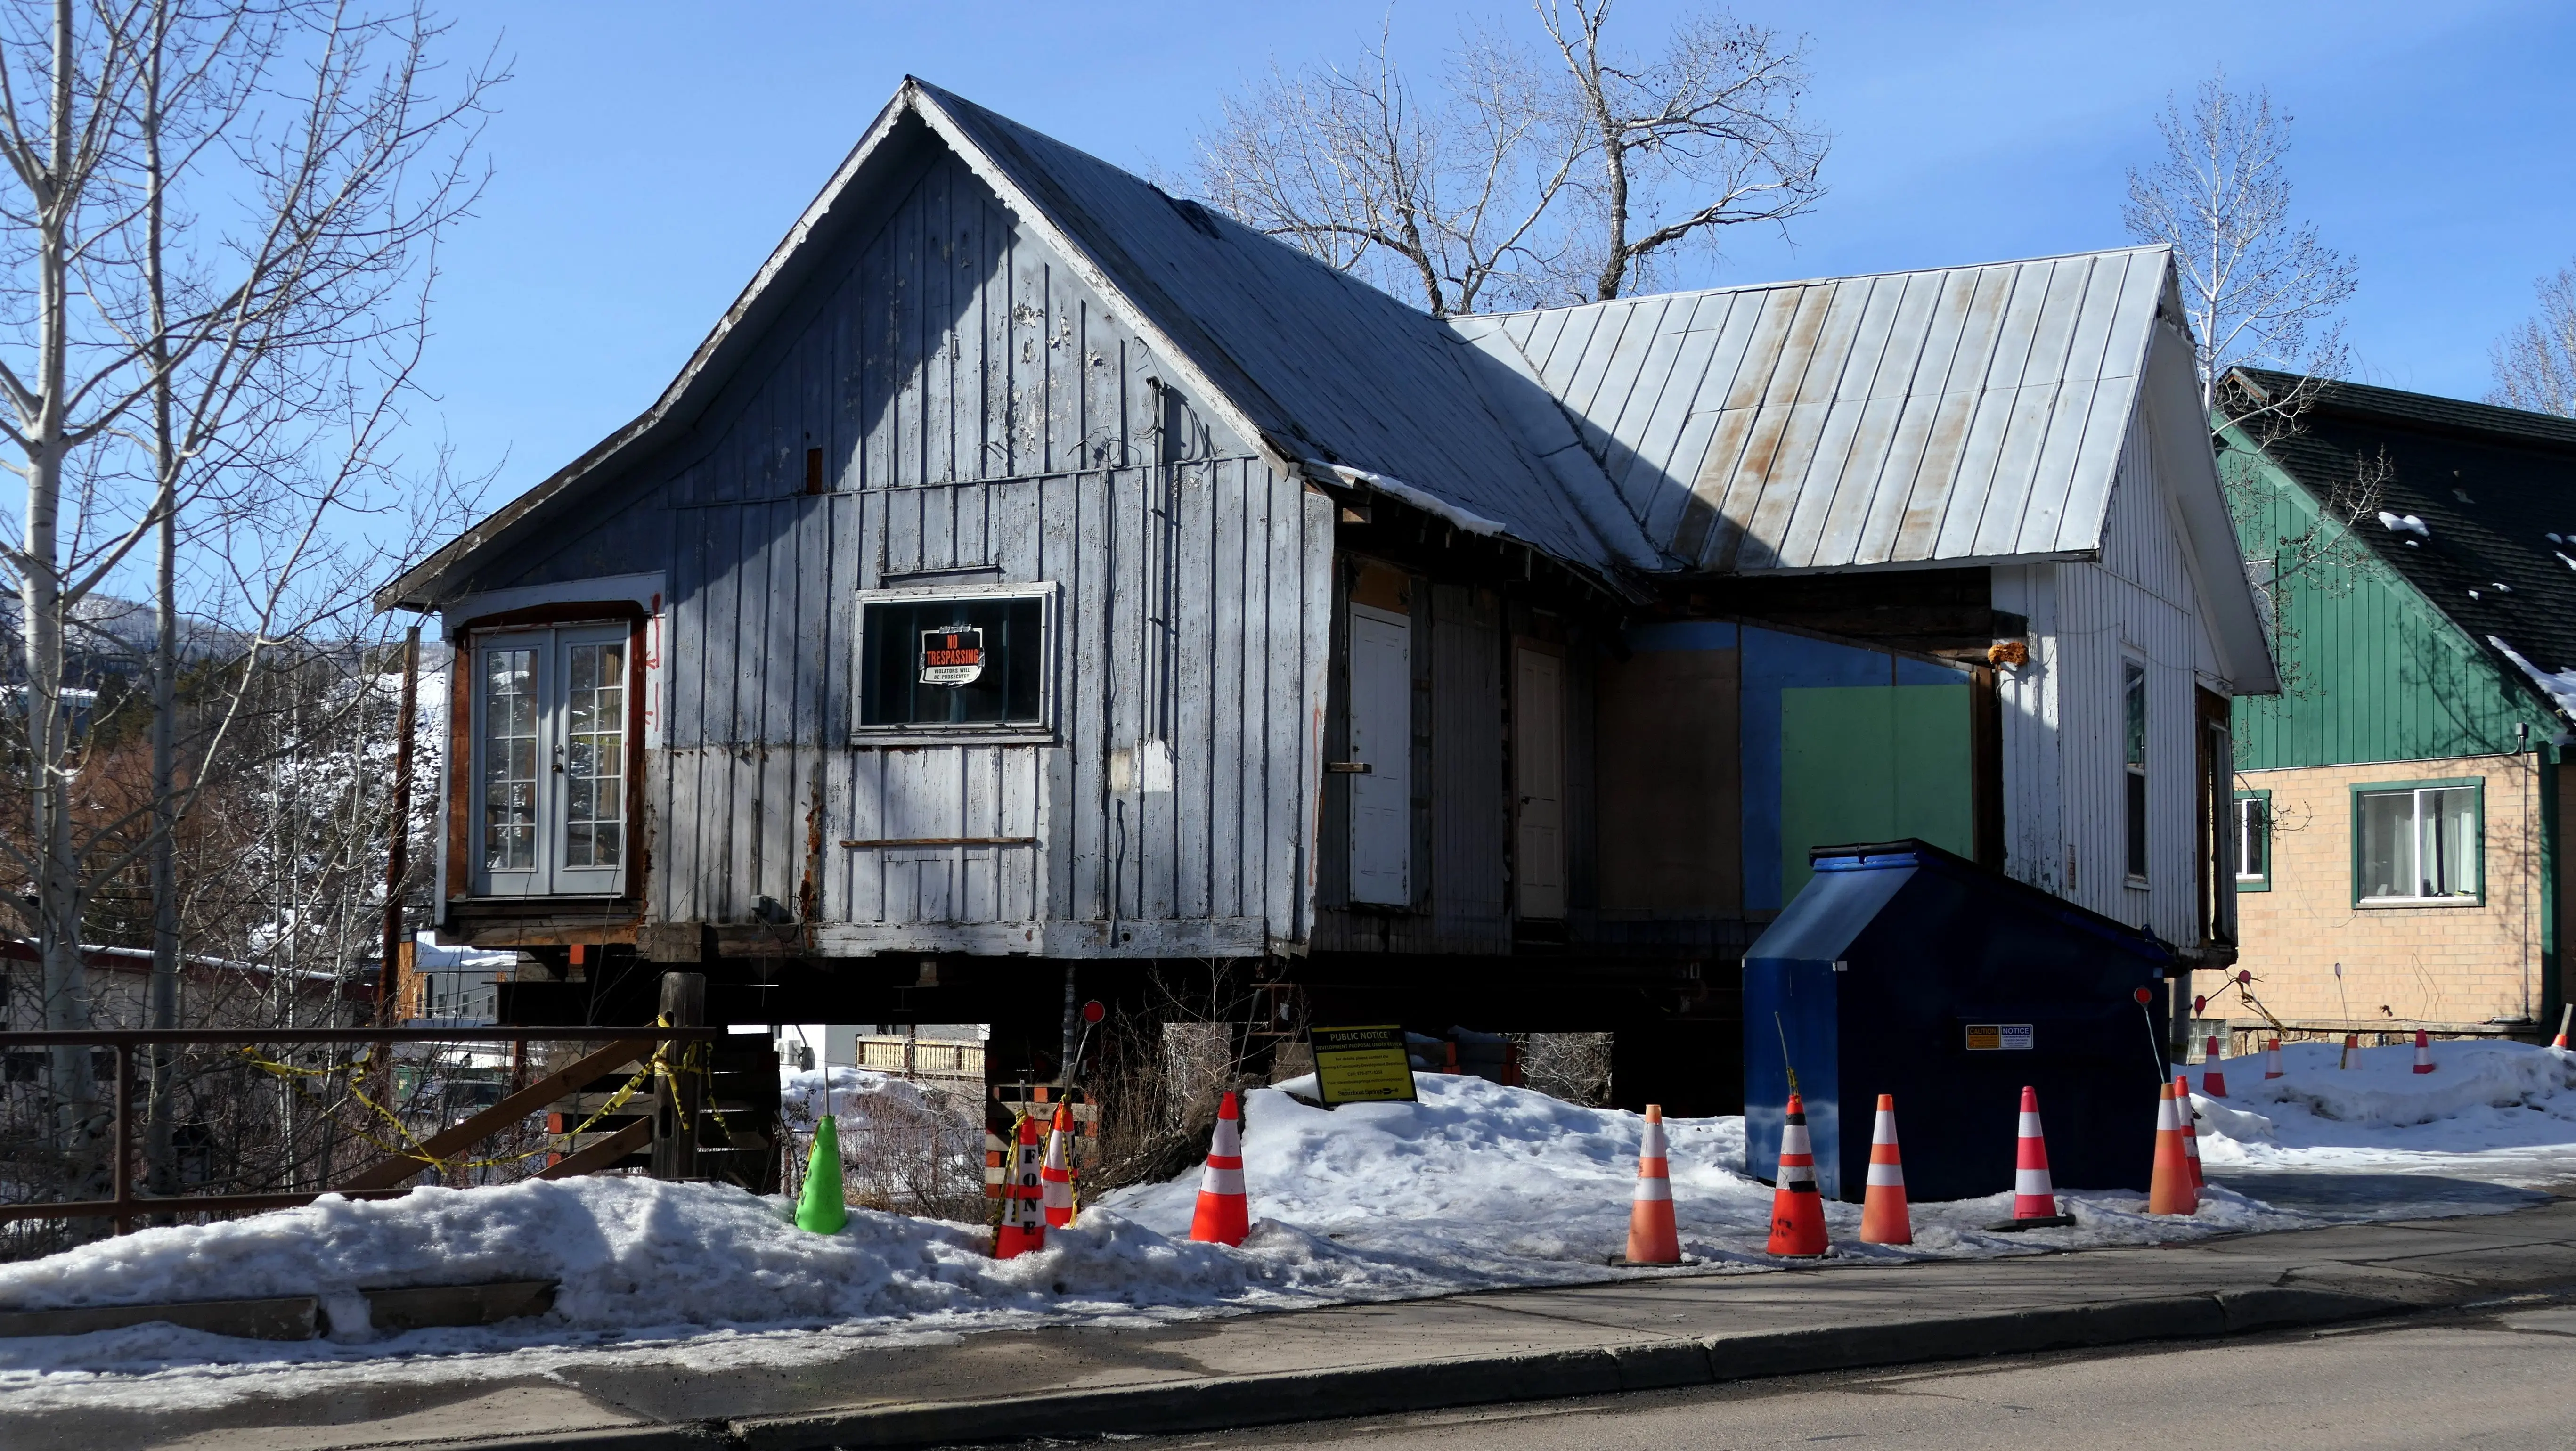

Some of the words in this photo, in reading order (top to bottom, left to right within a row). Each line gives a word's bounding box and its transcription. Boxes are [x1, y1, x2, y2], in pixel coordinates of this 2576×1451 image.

[947, 635, 958, 649] NO
[927, 649, 979, 665] TRESPASSING
[1330, 1032, 1359, 1041] PUBLIC
[1360, 1031, 1388, 1039] NOTICE
